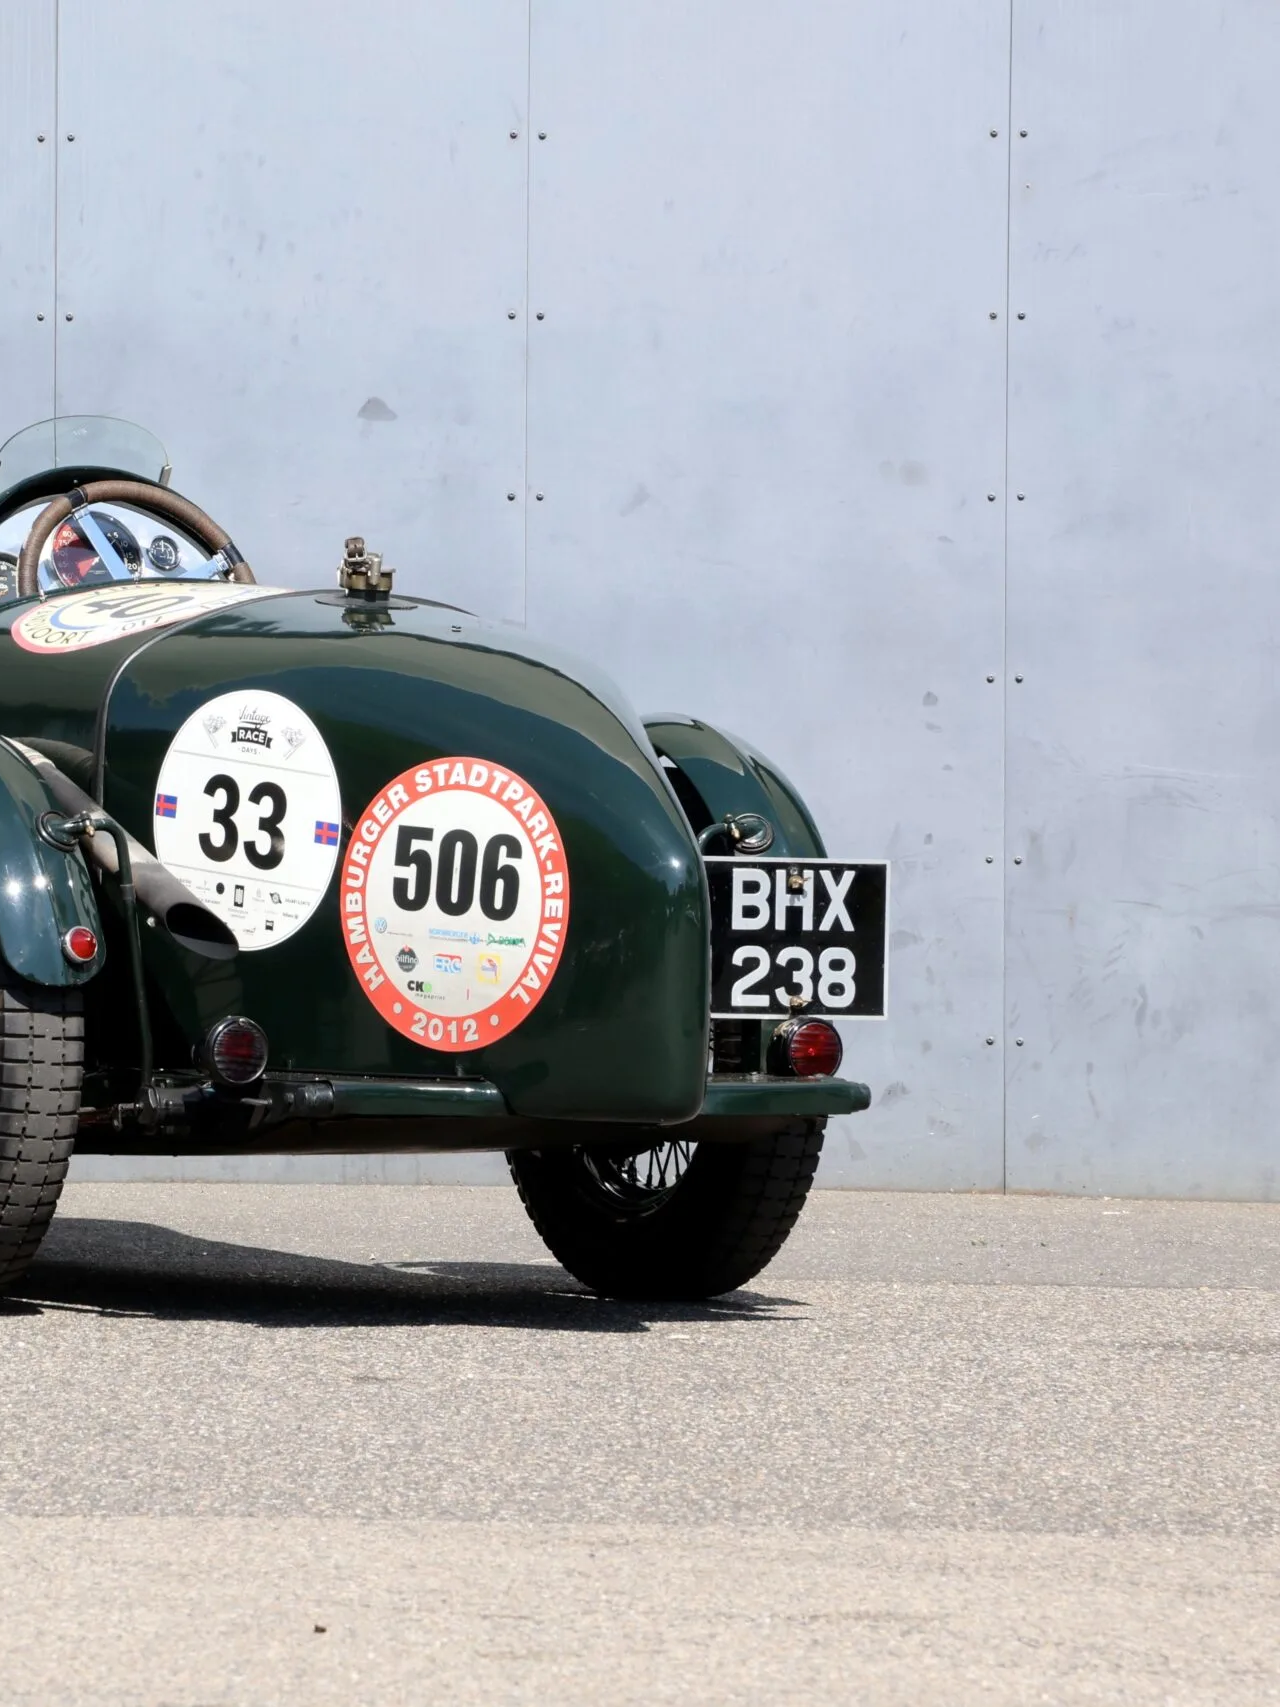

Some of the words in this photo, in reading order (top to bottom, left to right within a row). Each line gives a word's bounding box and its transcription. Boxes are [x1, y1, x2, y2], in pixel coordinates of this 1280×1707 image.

[82, 593, 195, 619] 40
[239, 704, 271, 728] Vintage
[239, 729, 266, 743] RACE
[241, 746, 258, 755] DAYS
[198, 773, 288, 871] 33
[345, 783, 410, 992] HAMBURGER
[415, 762, 564, 1005] STADTPARK-REVIVAL
[392, 825, 523, 922] 506
[731, 867, 856, 932] BHX
[731, 945, 856, 1008] 238
[410, 1012, 479, 1044] 2012
